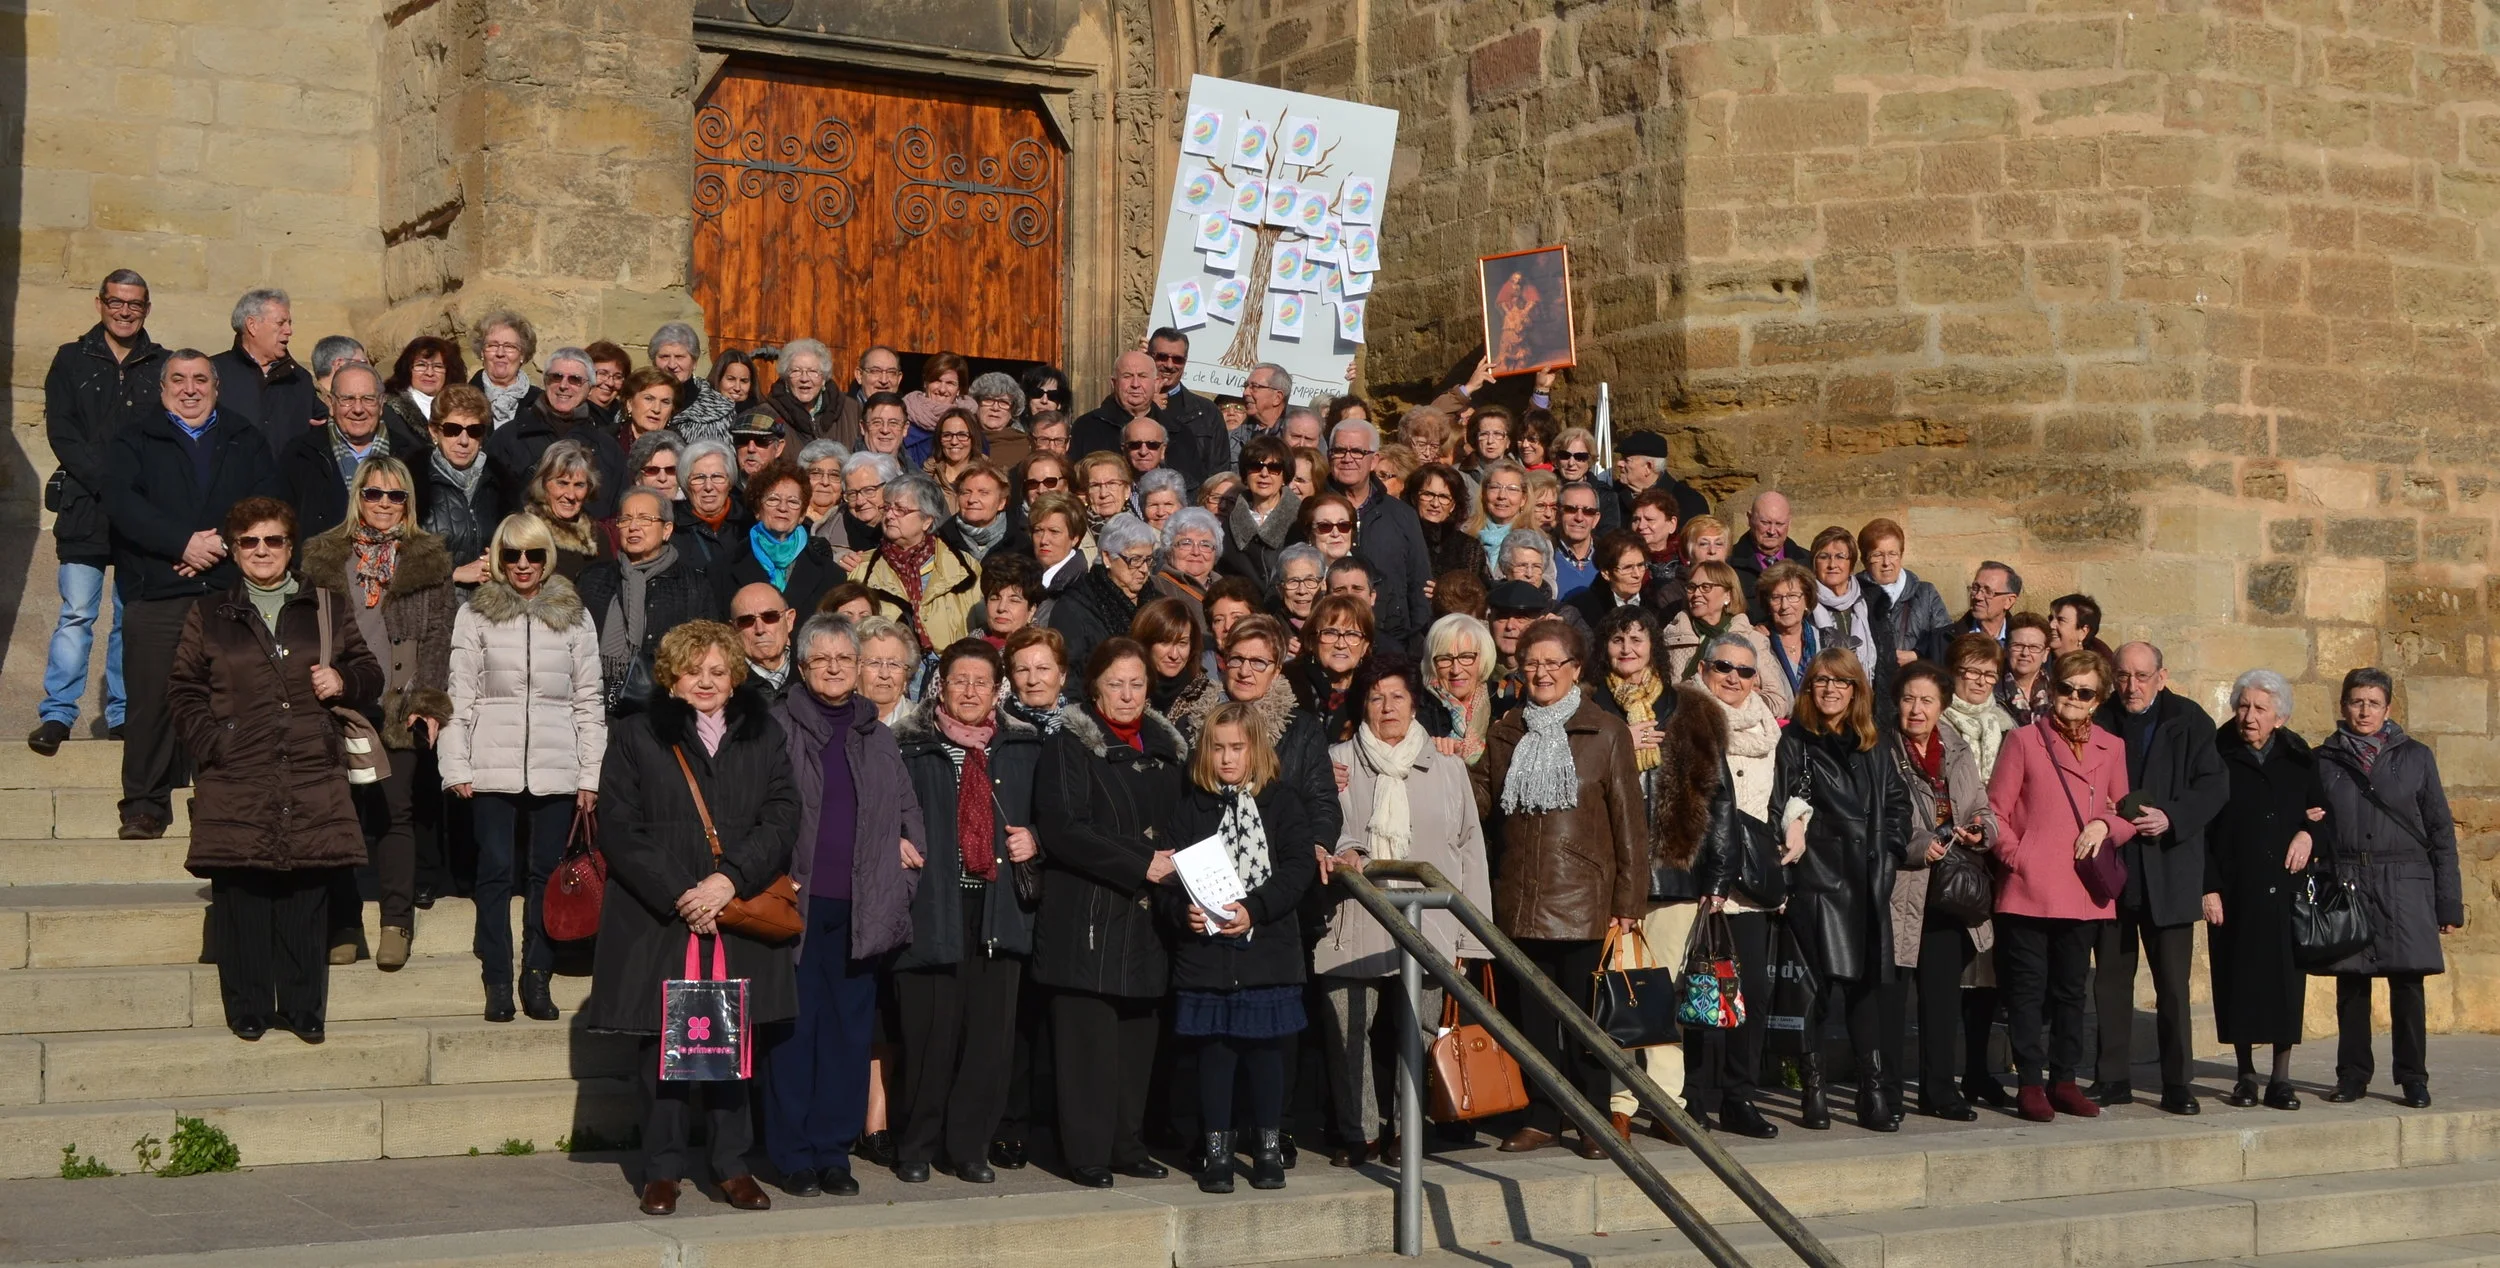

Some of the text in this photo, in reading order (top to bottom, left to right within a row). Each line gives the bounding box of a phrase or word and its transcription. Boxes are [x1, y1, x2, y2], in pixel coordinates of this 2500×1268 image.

[1192, 370, 1206, 383] de
[1209, 369, 1222, 386] la
[1225, 372, 1247, 388] VID
